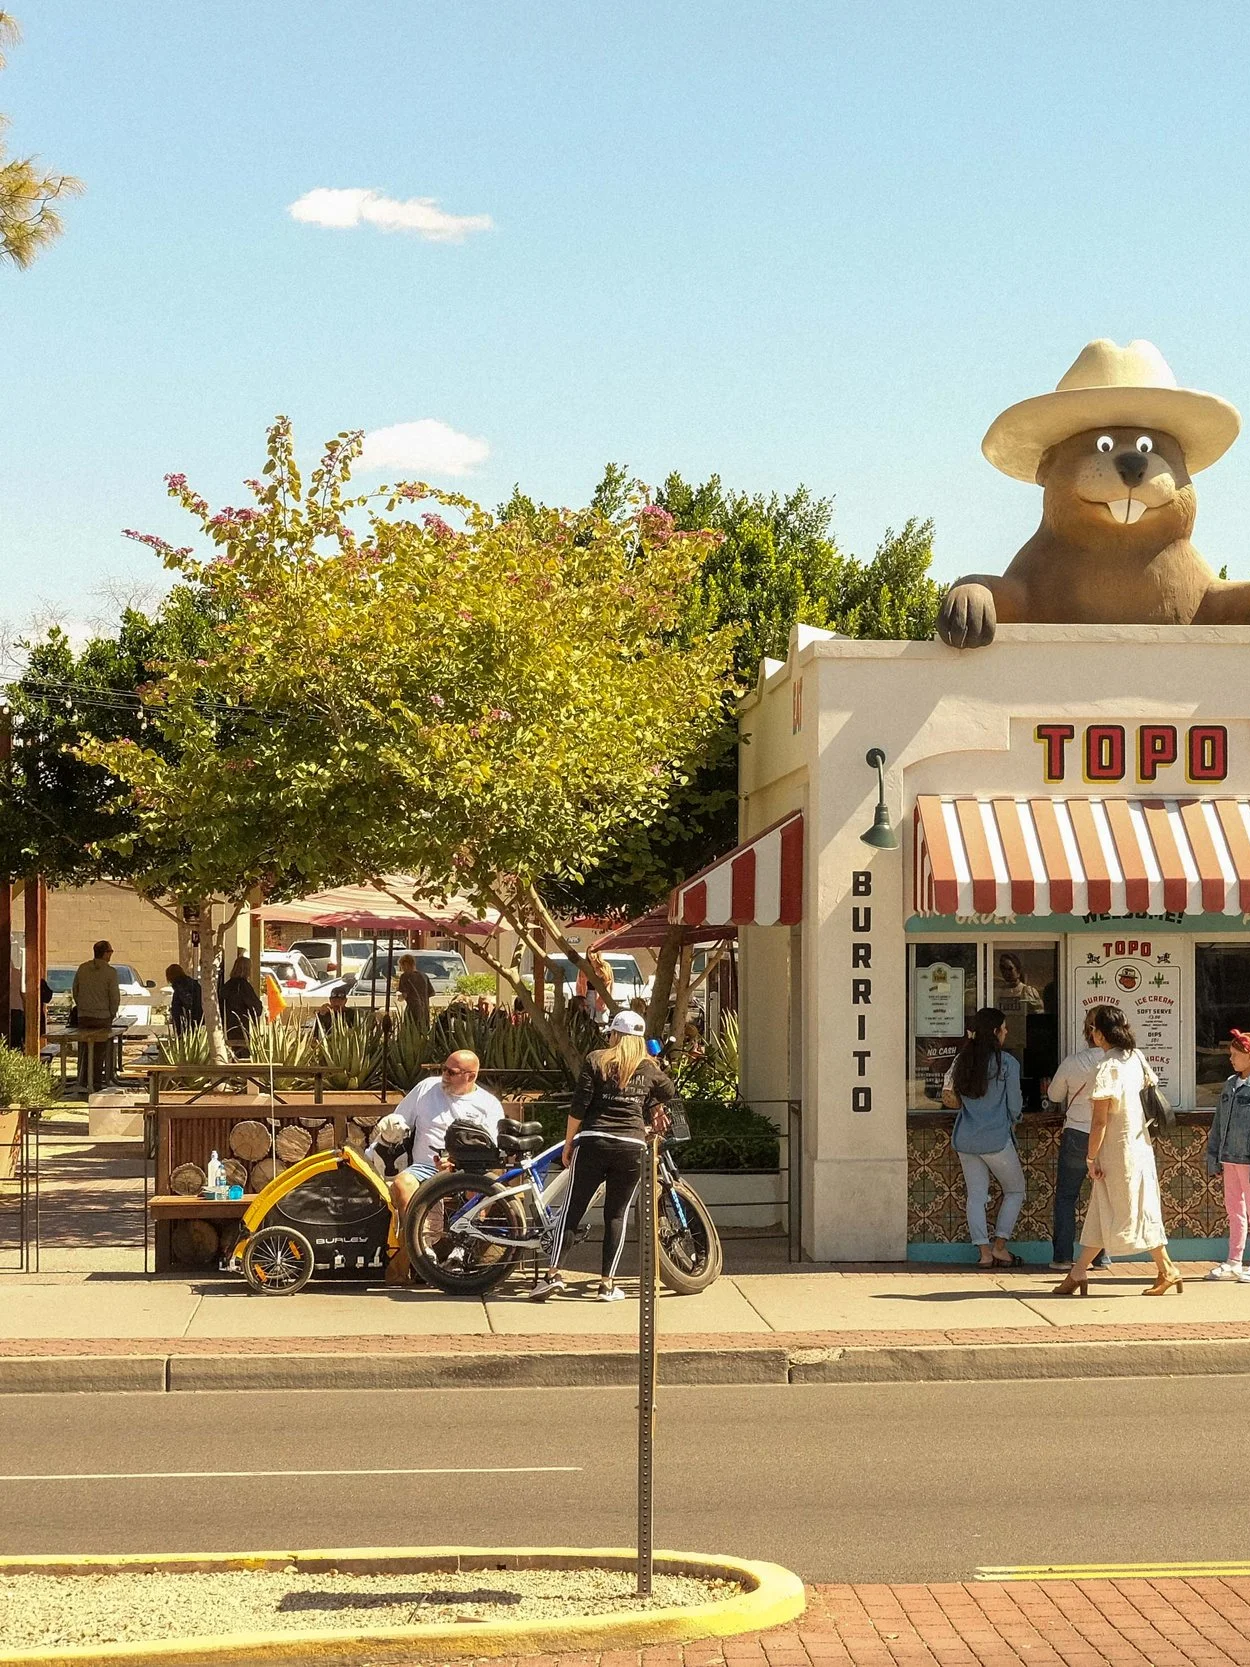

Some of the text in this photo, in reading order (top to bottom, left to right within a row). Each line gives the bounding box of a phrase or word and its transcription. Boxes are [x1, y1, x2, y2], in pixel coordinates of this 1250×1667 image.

[1034, 724, 1228, 784] TOPO
[1082, 911, 1184, 924] WEE!
[1103, 940, 1152, 958] TOPO
[851, 871, 872, 1113] BURRITO
[1082, 995, 1121, 1007] BURRITOS
[1134, 995, 1175, 1007] ICE CREAM
[927, 1046, 957, 1056] NO CASH
[1145, 1055, 1171, 1065] ACKS
[315, 1236, 369, 1245] BURLEY
